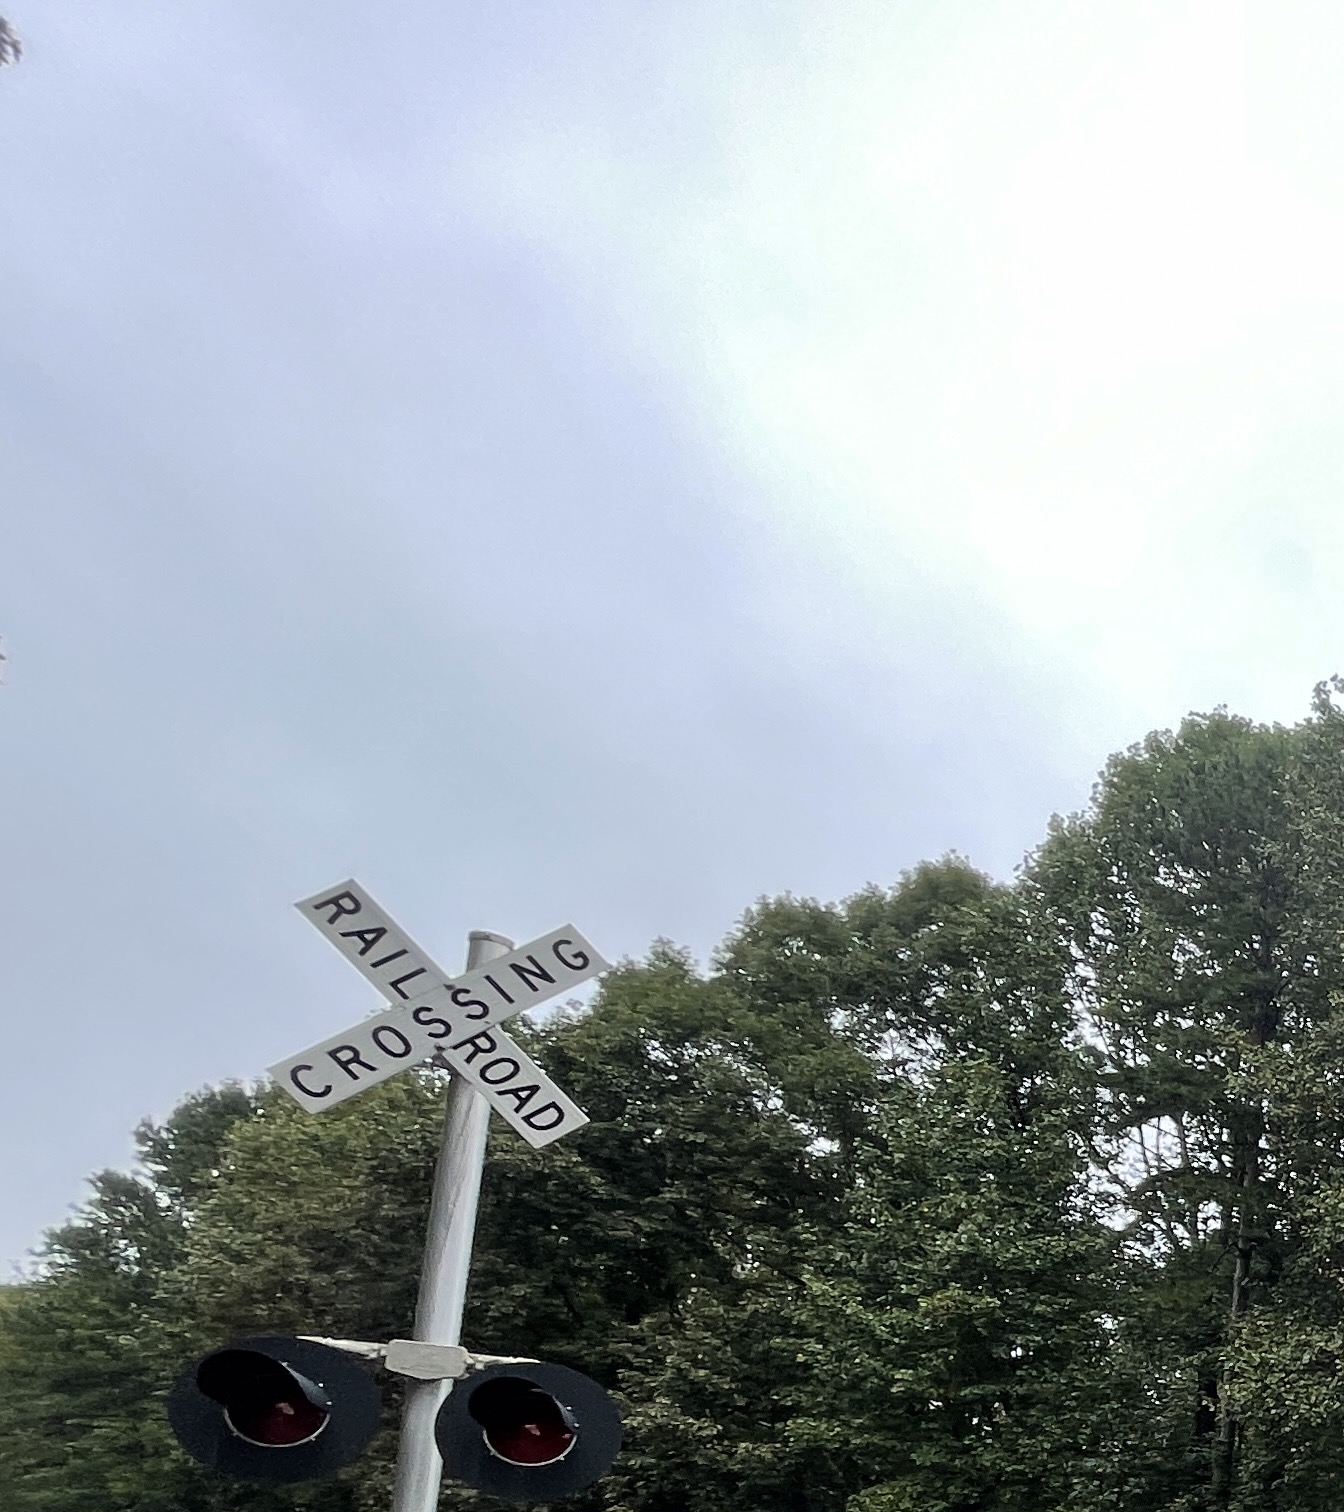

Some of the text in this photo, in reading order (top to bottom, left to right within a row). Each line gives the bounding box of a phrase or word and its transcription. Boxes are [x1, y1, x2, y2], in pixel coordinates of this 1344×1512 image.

[290, 939, 590, 1098] CROSSING
[313, 890, 565, 1131] RAIL ROAD
